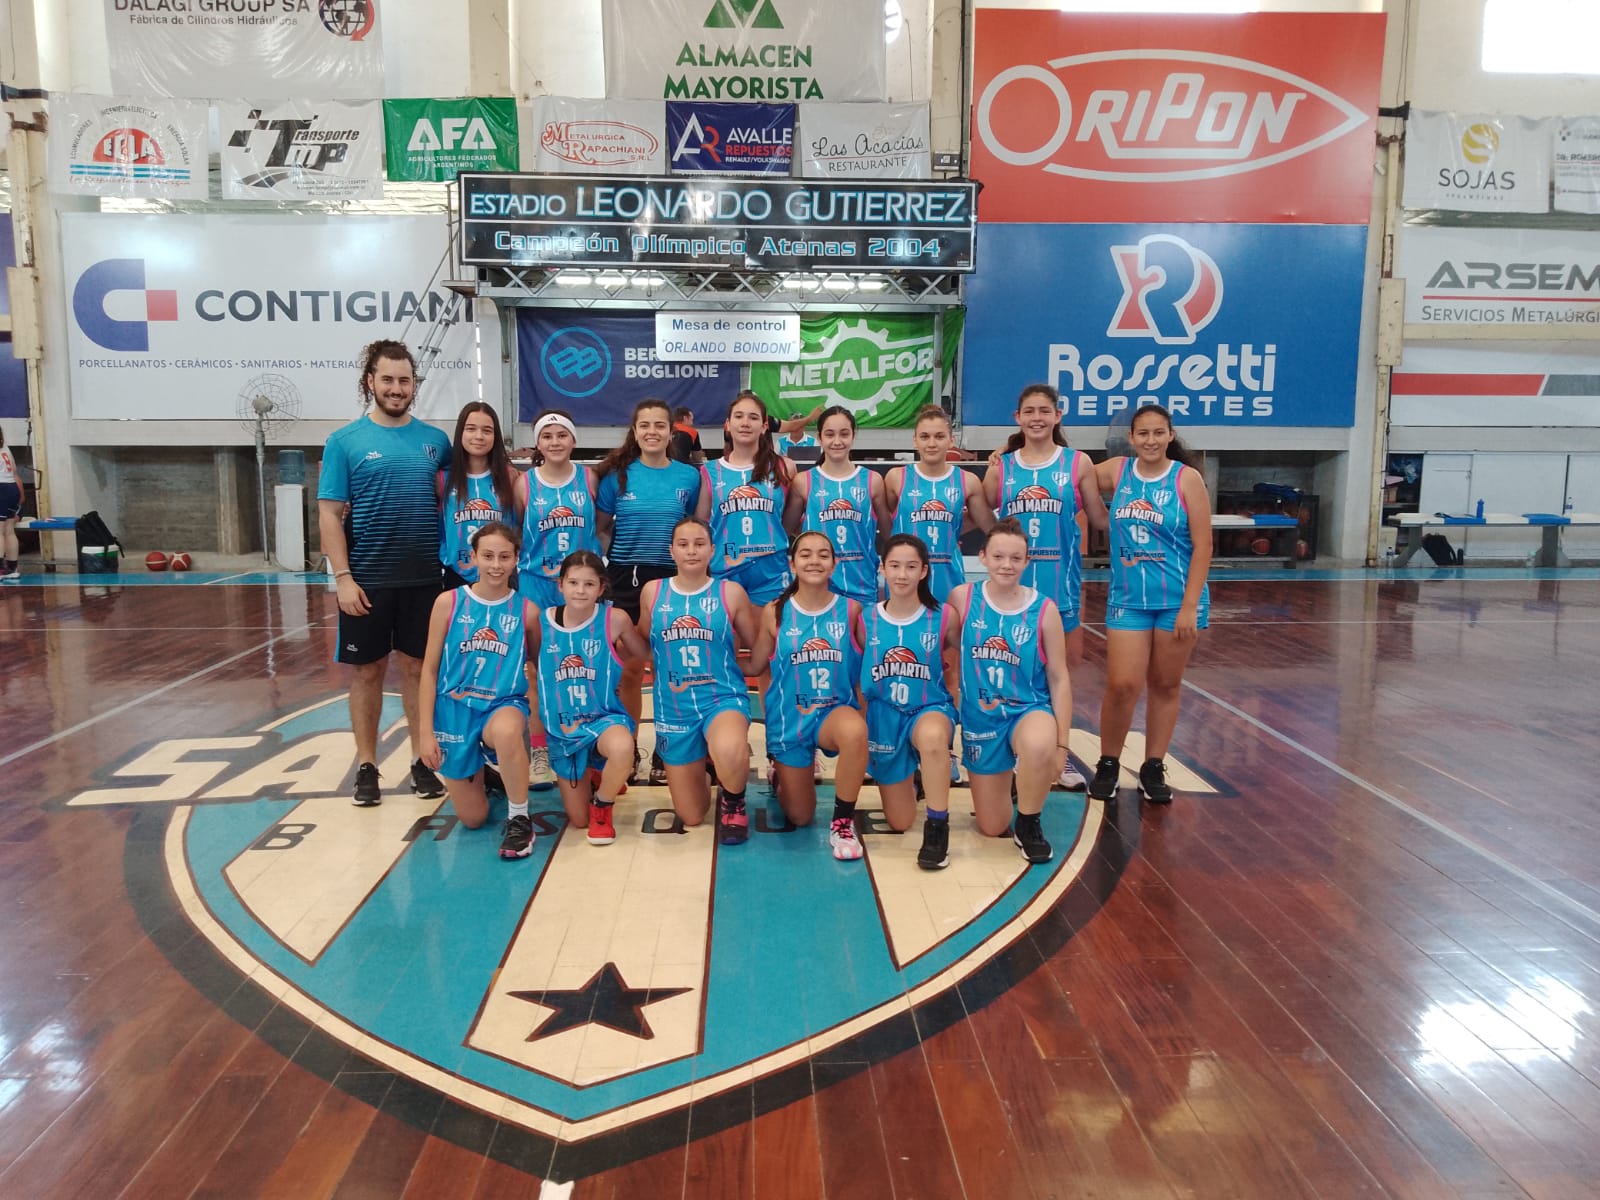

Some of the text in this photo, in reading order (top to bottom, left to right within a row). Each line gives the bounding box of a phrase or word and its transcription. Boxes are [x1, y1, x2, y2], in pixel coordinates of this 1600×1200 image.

[130, 14, 168, 25] Fábrica
[171, 15, 184, 25] de
[676, 42, 812, 68] ALMACEN
[663, 74, 824, 99] MAYORISTA
[407, 117, 497, 151] AFA
[726, 127, 792, 145] AVALLE
[562, 140, 646, 164] RAPACHIANI
[725, 145, 792, 157] REPUESTOS
[812, 134, 924, 157] Las Acacias
[828, 157, 907, 172] RESTAURANTE
[1438, 168, 1516, 190] SOJAS
[470, 186, 966, 223] ESTADIO LEONARDO GUTIERREZ
[494, 231, 940, 258] Campeón Olímpico Atenas 2004
[195, 289, 474, 323] CONTIGIANI
[1421, 306, 1505, 322] SERVICIOS
[672, 318, 786, 331] Mesa de control
[79, 359, 167, 369] PORCELLANATOS
[174, 357, 233, 369] CERÁMICOS
[240, 359, 302, 369] SANITARIOS
[624, 347, 658, 362] BER
[624, 364, 719, 379] BOGLIONE
[779, 347, 934, 388] METALFOR
[1048, 343, 1277, 392] Rossetti
[720, 497, 774, 516] SAN MARTIN
[819, 510, 834, 522] SAN
[911, 510, 926, 523] SAN
[1007, 500, 1024, 516] SAN
[1115, 507, 1164, 526] SAN MARTIN
[454, 510, 471, 524] SAN
[538, 516, 585, 532] SAN MARTIN
[836, 525, 847, 545] 9
[927, 526, 939, 545] 4
[1029, 518, 1041, 538] 6
[1129, 524, 1150, 544] 15
[558, 532, 570, 552] 5
[661, 627, 714, 643] SAN MARTIN
[678, 645, 701, 668] 13
[791, 648, 843, 665] SAN MARTIN
[971, 646, 1021, 667] SAN MARTIN
[475, 656, 486, 678] 7
[808, 667, 830, 690] 12
[986, 667, 1005, 689] 11
[567, 685, 588, 707] 14
[889, 681, 910, 705] 10
